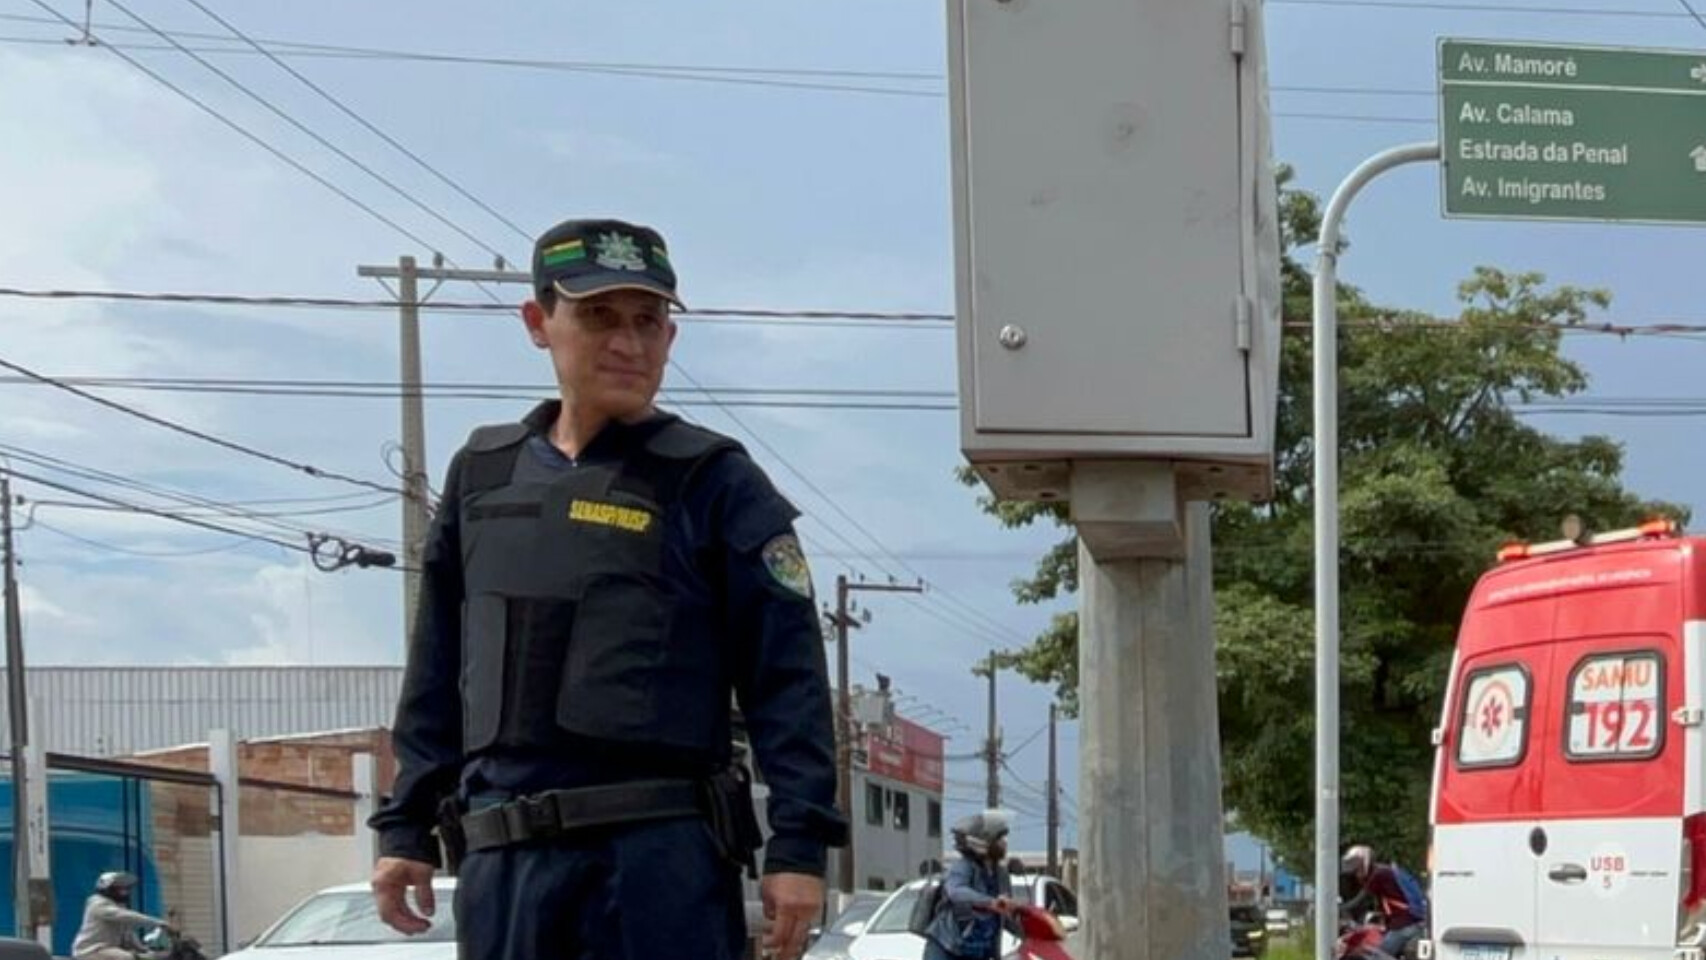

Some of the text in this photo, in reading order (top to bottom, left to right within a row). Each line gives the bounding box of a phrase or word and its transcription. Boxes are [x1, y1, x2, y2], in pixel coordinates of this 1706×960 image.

[1458, 51, 1578, 77] Av. Mamoré
[1459, 101, 1575, 126] Av. Calama
[1459, 138, 1628, 165] Estrada da Penal
[1461, 175, 1606, 204] Av. Imigrantes
[1582, 659, 1651, 691] SAMU
[1583, 699, 1651, 748] 192
[1590, 856, 1625, 872] USB
